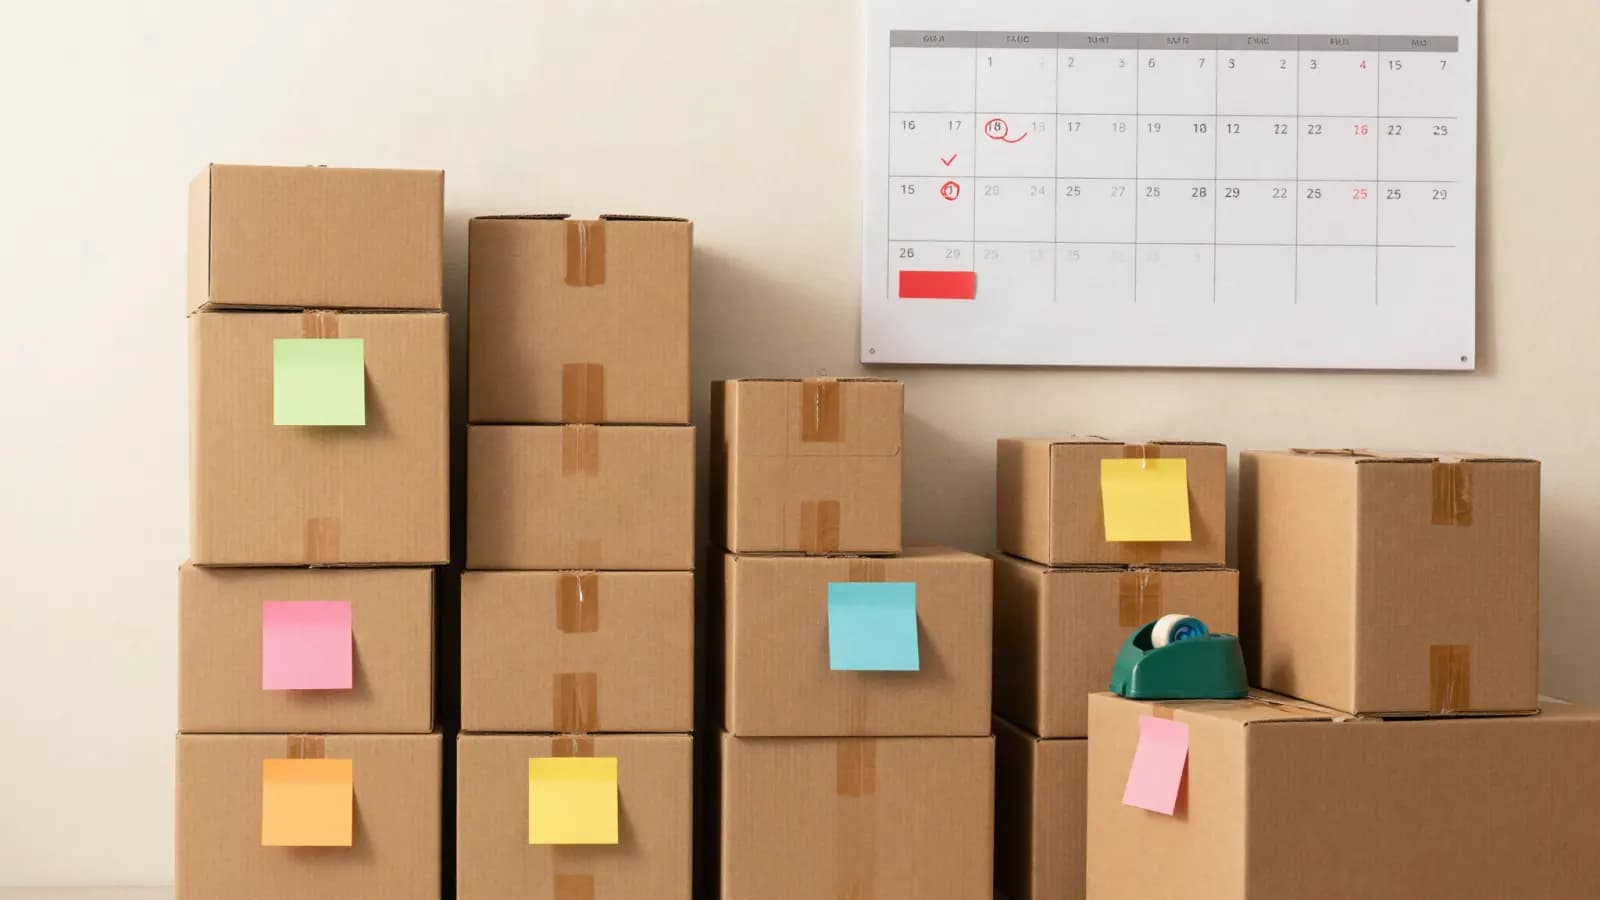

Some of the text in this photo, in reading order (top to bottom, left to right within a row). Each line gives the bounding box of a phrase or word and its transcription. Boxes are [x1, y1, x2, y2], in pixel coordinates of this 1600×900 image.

[1067, 56, 1076, 69] 2
[1147, 57, 1156, 69] 6
[1198, 57, 1207, 69] 7
[1279, 58, 1287, 70] 2
[1309, 58, 1318, 70] 3
[1359, 59, 1367, 71] 4
[1388, 59, 1403, 71] 15
[1439, 59, 1448, 71] 7
[901, 119, 916, 131] 16
[947, 120, 962, 132] 17
[1066, 121, 1081, 133] 17
[1146, 122, 1162, 134] 19
[1226, 123, 1241, 135] 12
[1387, 124, 1402, 136] 22
[900, 184, 916, 196] 15
[1065, 185, 1081, 197] 25
[1191, 186, 1208, 198] 28
[1224, 187, 1241, 199] 29
[1272, 187, 1288, 199] 22
[1306, 188, 1322, 200] 25
[1352, 188, 1369, 200] 25
[1386, 188, 1402, 200] 25
[899, 247, 915, 259] 26
